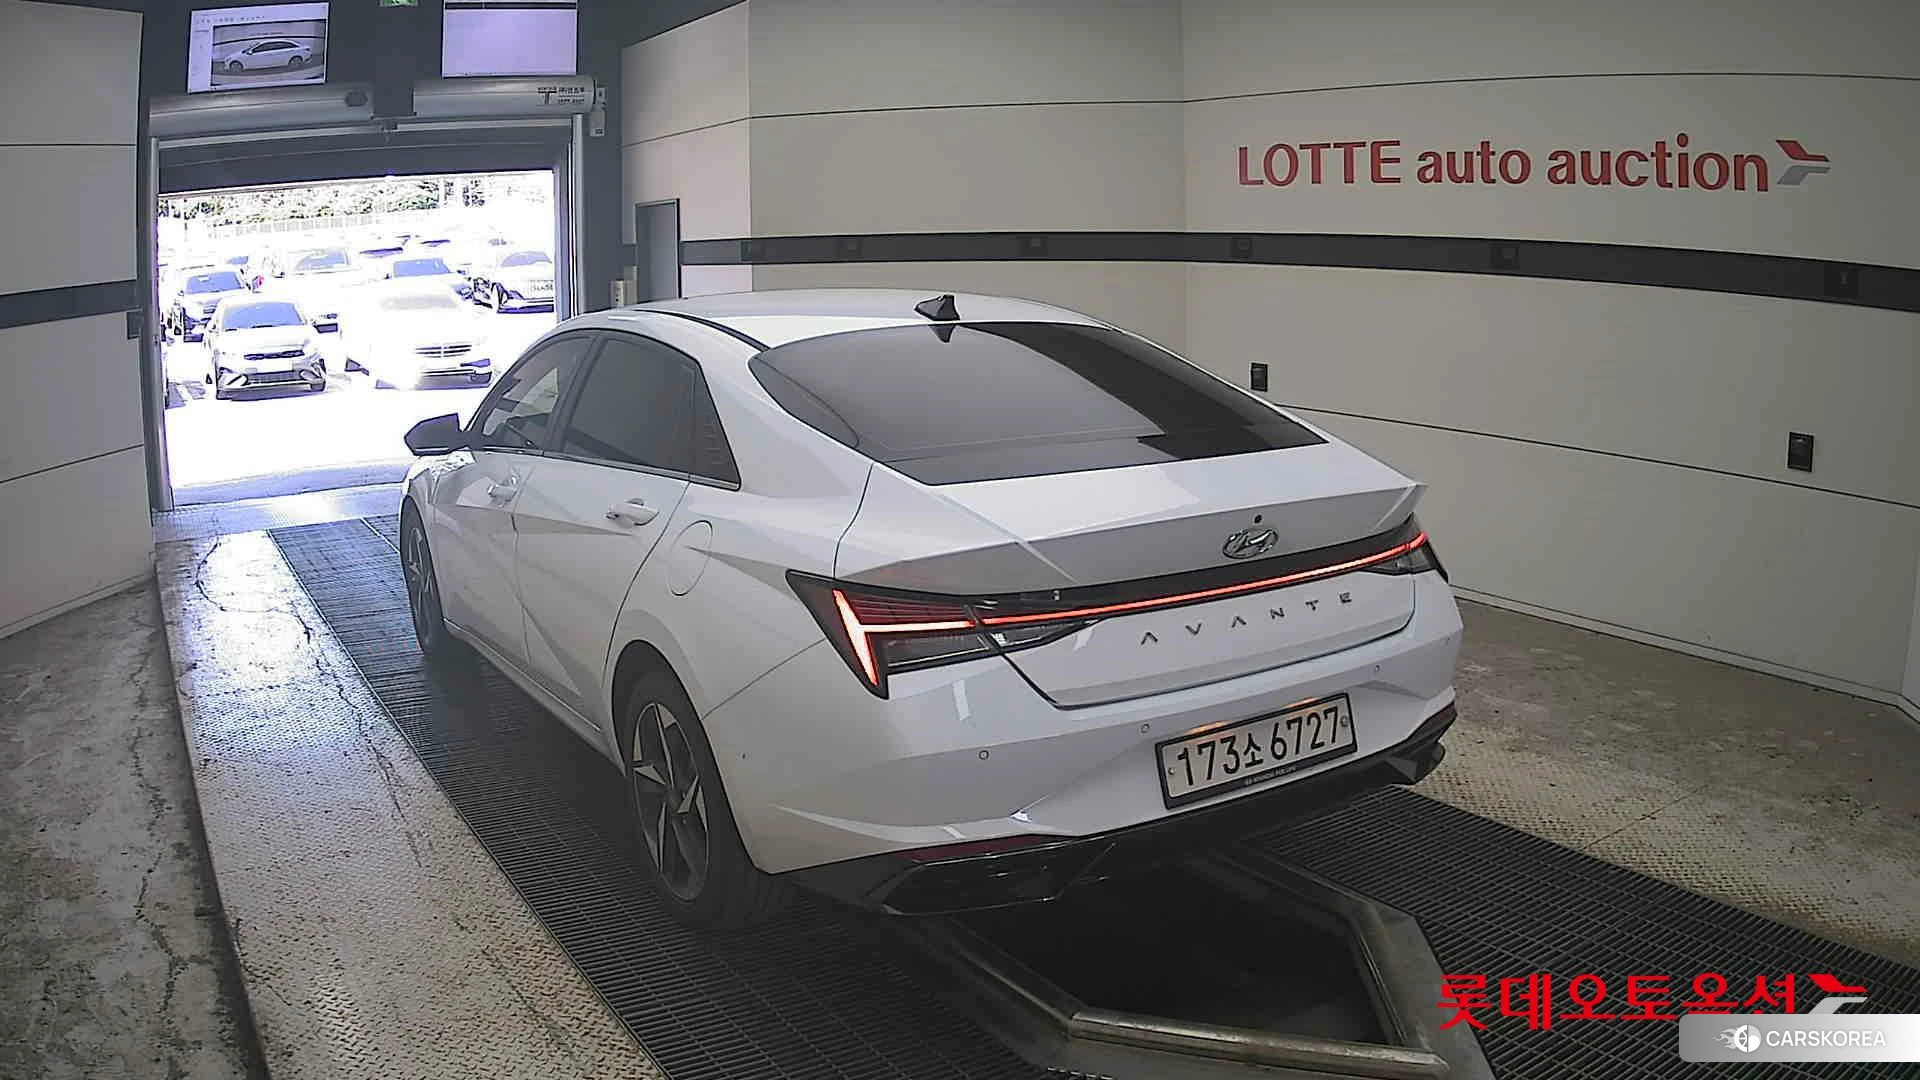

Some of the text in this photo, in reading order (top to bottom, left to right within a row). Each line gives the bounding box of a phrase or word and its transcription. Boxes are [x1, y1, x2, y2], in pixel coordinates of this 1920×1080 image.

[1238, 133, 1769, 193] LOTTE auto auction
[1139, 590, 1354, 647] AVANTE
